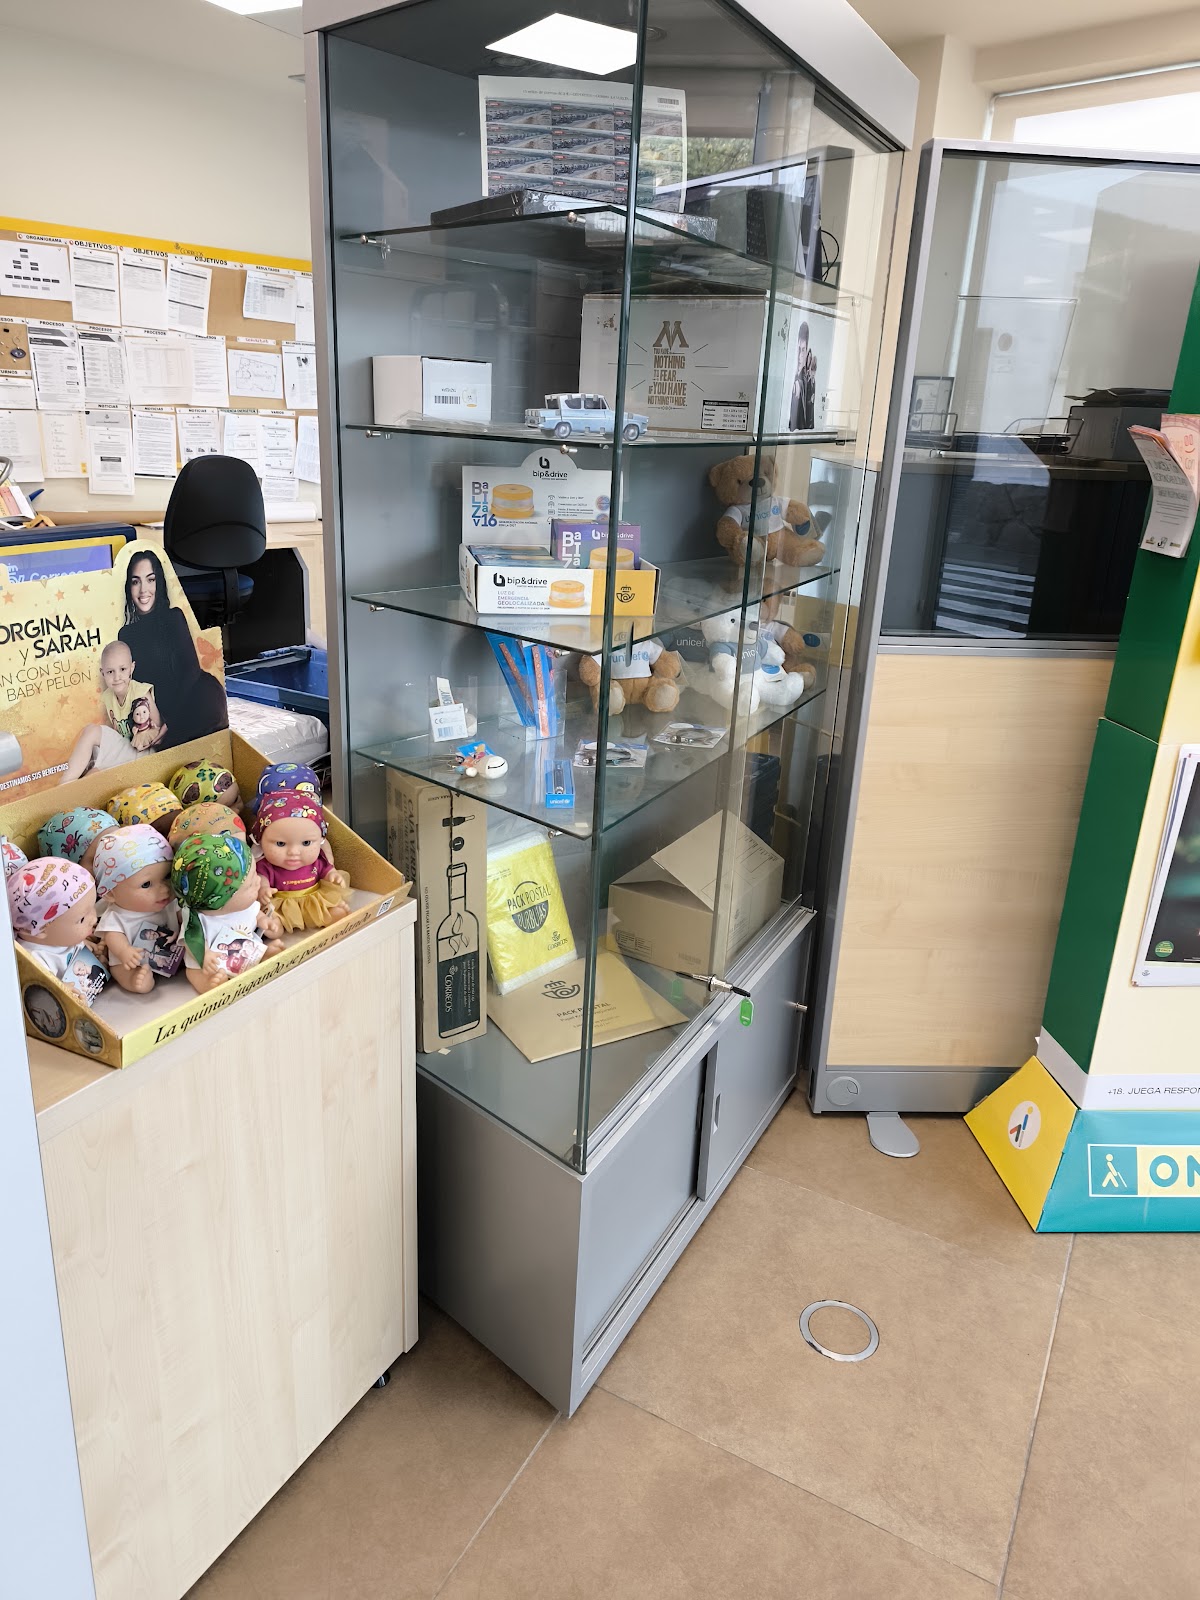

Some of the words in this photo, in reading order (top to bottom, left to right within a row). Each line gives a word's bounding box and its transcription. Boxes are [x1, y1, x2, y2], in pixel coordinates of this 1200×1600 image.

[74, 241, 112, 250] OBJETIVOS
[133, 248, 168, 258] OBJETIVOS
[194, 256, 227, 265] OBJETIVOS
[654, 355, 686, 369] NOTHING
[653, 382, 668, 395] YOU
[668, 382, 687, 396] HAVE
[648, 395, 669, 405] NOTHING
[473, 514, 497, 527] v16
[507, 577, 548, 585] bip&drive
[33, 628, 101, 658] SARAH
[677, 637, 705, 647] unicef
[16, 664, 50, 682] CON
[53, 659, 70, 674] SU
[7, 681, 42, 701] BABY
[46, 669, 91, 691] PELÓN
[0, 774, 31, 791] DESTINAMOS
[32, 771, 41, 780] SUS
[42, 763, 69, 778] BENEFICIOS
[406, 799, 416, 834] CAJA
[507, 893, 525, 911] PACK
[525, 884, 551, 903] POSTAL
[517, 903, 547, 930] BURBUJAS
[154, 1024, 175, 1045] La
[180, 993, 231, 1030] quimio
[229, 962, 286, 1004] jugando
[286, 954, 300, 968] se
[298, 939, 328, 965] pasa
[329, 912, 372, 942] volando
[442, 974, 456, 1013] CORREOS
[557, 1008, 577, 1017] PACK
